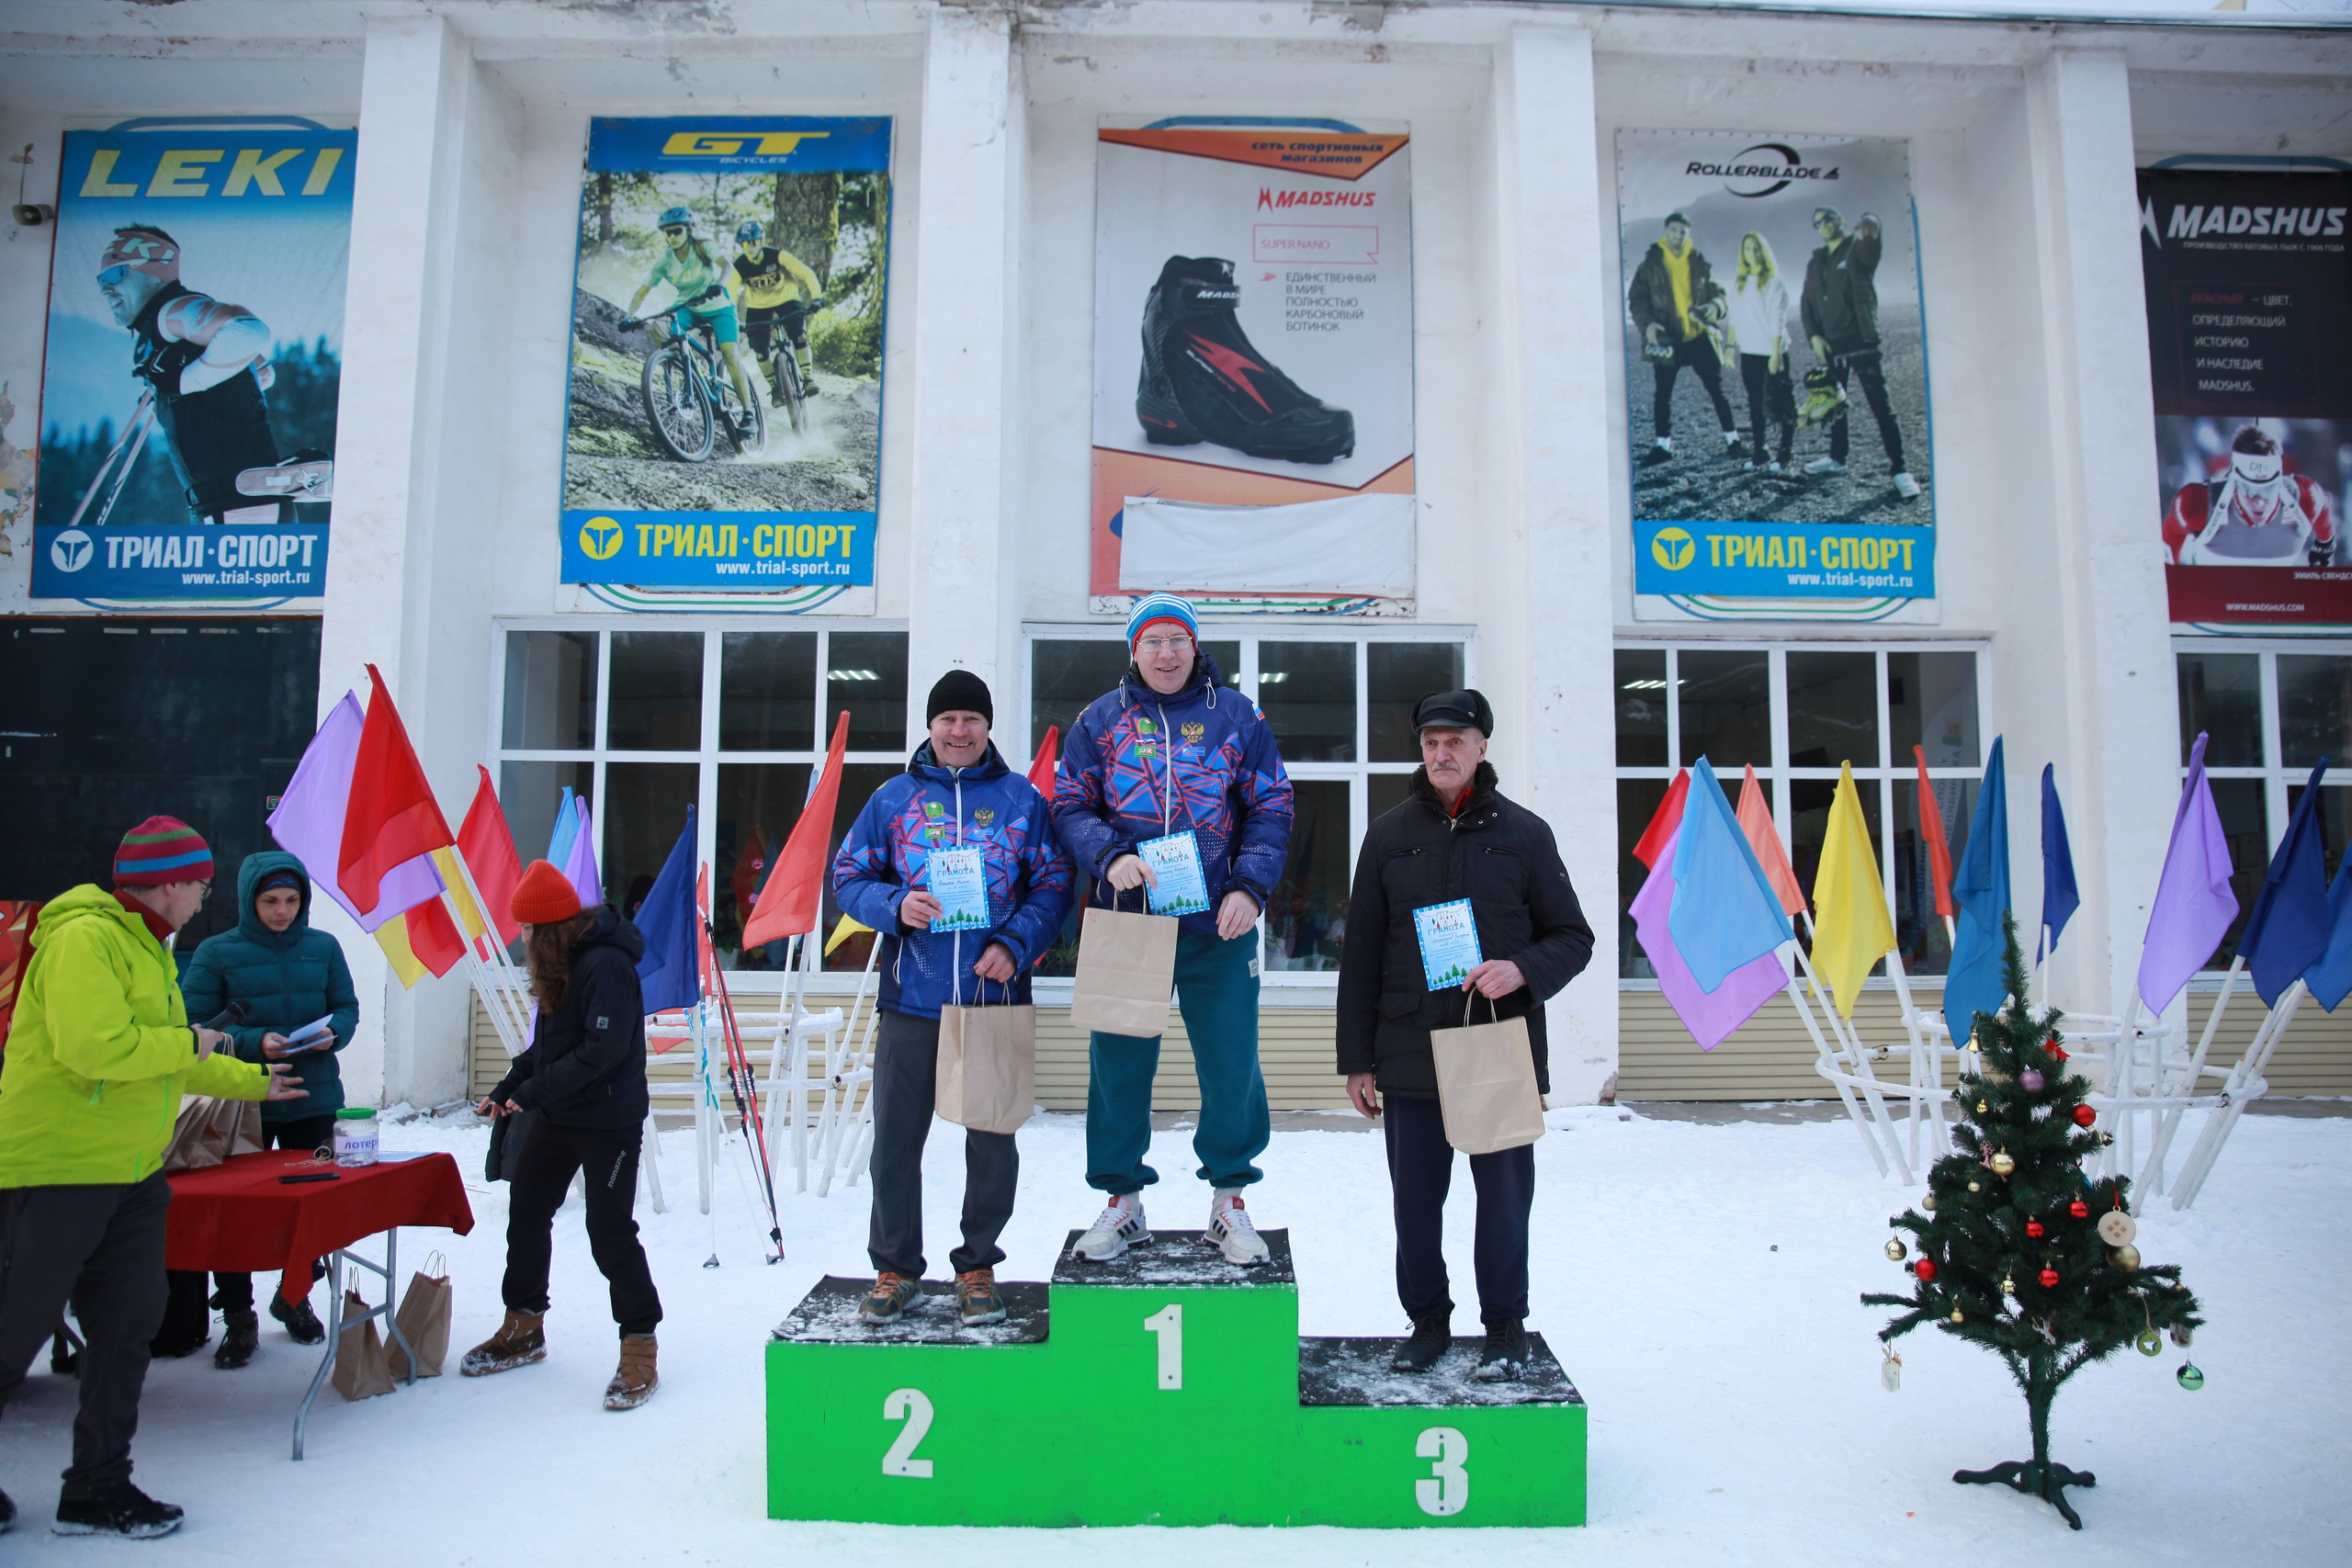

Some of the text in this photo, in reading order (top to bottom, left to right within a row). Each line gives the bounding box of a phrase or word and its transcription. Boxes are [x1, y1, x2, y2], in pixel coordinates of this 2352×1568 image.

[662, 131, 831, 154] GT
[1252, 141, 1384, 153] сеть спортивных
[1281, 154, 1363, 164] магазинов
[78, 148, 344, 197] LEKI
[1275, 190, 1376, 209] MADSHUS
[2166, 205, 2346, 239] MADSHUS
[1261, 240, 1330, 250] SUPER NANO
[1286, 272, 1376, 283] ЕДИНСТВЕННЫЙ
[1286, 285, 1327, 295] В МИРЕ
[1286, 297, 1358, 308] ПОЛНОСТЬЮ
[1286, 310, 1363, 320] КАРБОНОВЫЙ
[2192, 314, 2286, 328] ОПРЕДЕЛЯЮЩИЙ
[1286, 321, 1340, 332] БОТИНОК
[2195, 336, 2249, 348] ИСТОРИЮ
[2207, 358, 2264, 371] НАСЛЕДИЕ
[716, 560, 851, 577] www.trial-sport.ru
[182, 570, 311, 587] www.trial-sport.ru
[1788, 572, 1914, 589] www.trial-sport.ru
[1152, 853, 1190, 868] ГРАМОТА
[937, 867, 975, 877] ГРАМОТА
[1428, 922, 1464, 936] ГРАМОТА
[734, 1070, 744, 1098] NORDWAY
[744, 1068, 754, 1097] NORDWAY
[608, 1150, 627, 1189] noname
[1144, 1303, 1182, 1390] 1
[882, 1387, 934, 1478] 2
[1415, 1426, 1468, 1517] 3
